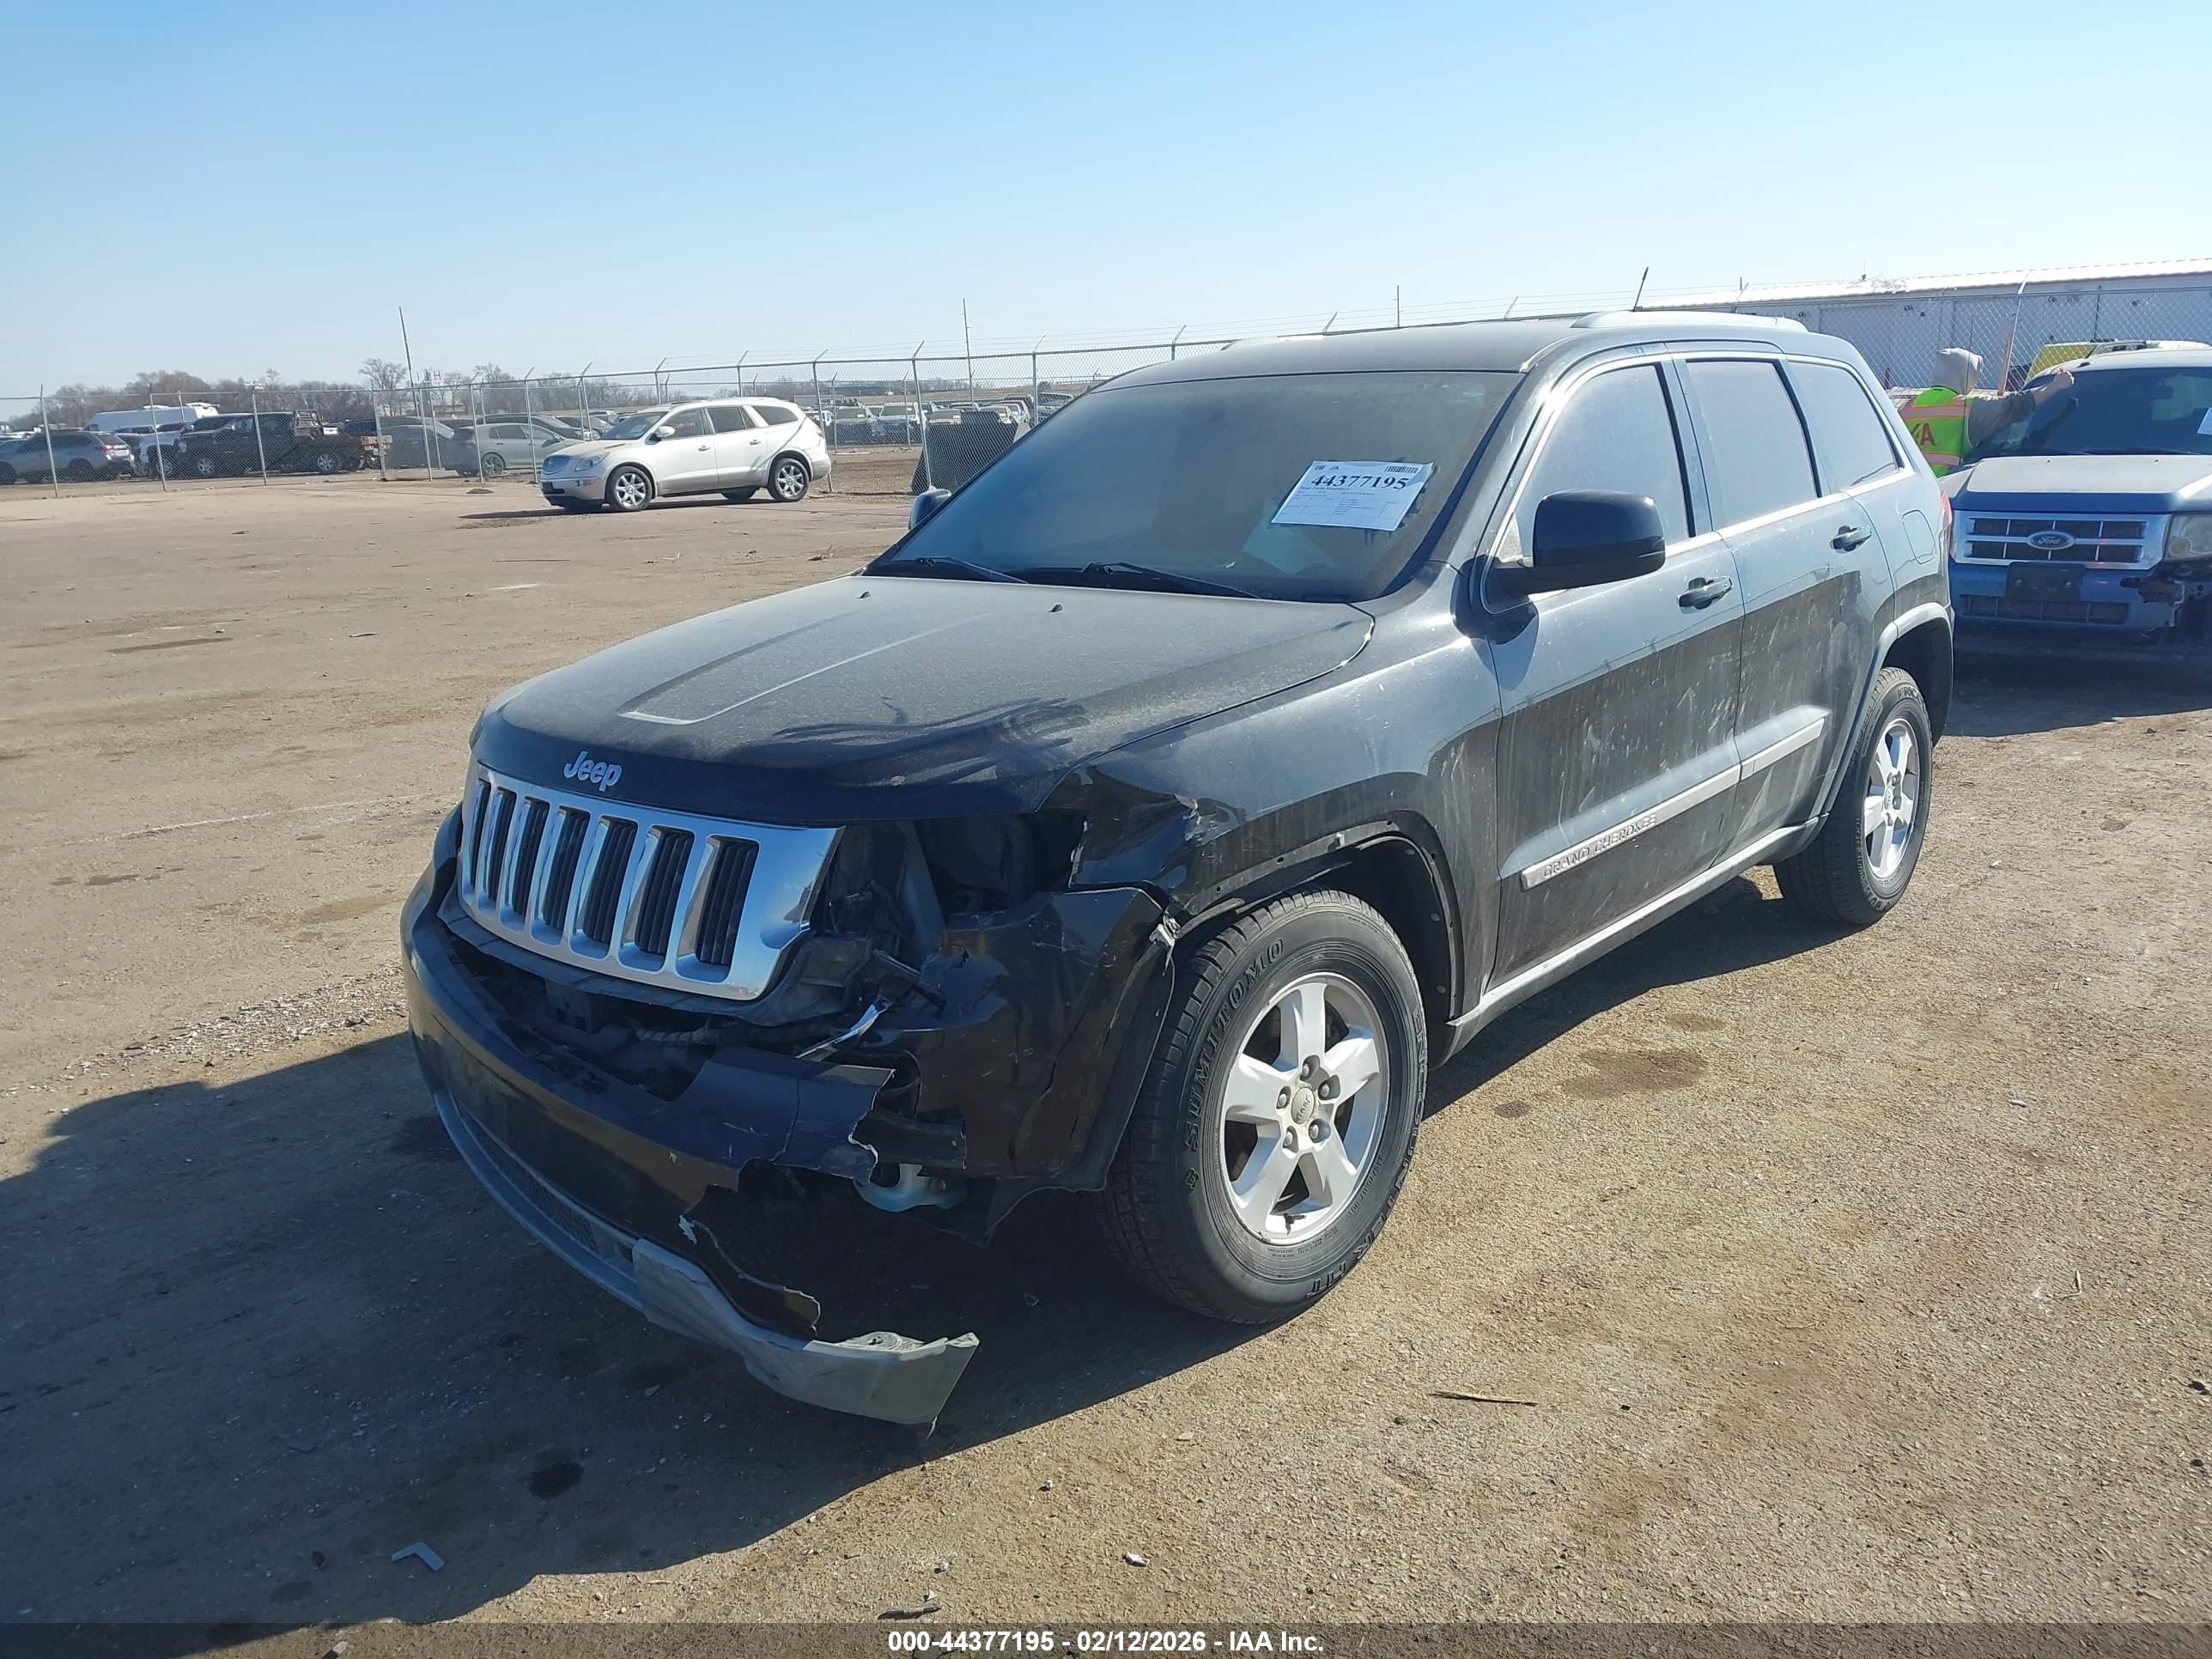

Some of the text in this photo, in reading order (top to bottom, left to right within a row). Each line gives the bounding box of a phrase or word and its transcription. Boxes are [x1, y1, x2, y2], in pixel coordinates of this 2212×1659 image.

[1311, 475, 1409, 489] 44377195
[563, 750, 623, 791] Jeep
[1543, 813, 1656, 878] GRAND CHEROKEE
[1184, 938, 1285, 1152] SUMITOMO
